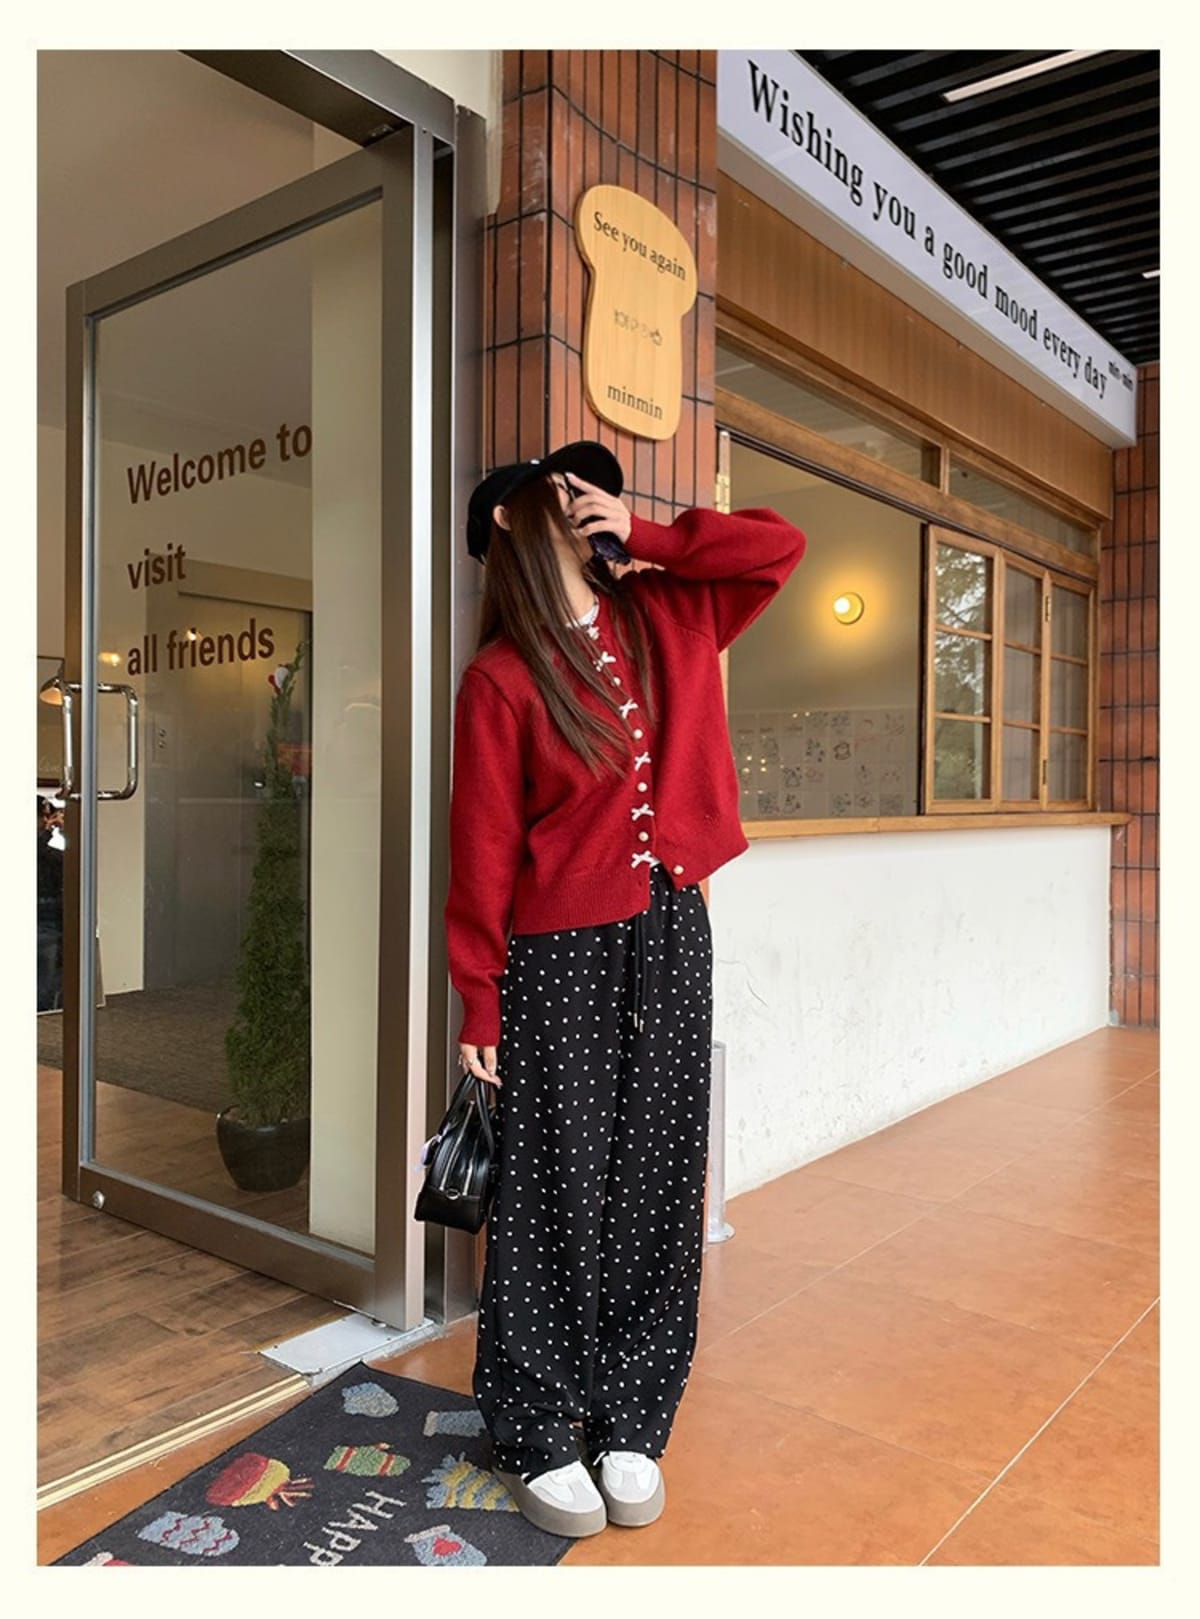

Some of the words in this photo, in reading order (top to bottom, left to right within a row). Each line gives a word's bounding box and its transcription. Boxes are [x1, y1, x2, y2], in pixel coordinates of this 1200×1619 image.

[593, 211, 619, 242] See
[622, 232, 648, 258] you
[649, 249, 686, 281] again
[747, 59, 864, 207] Wishing
[872, 181, 916, 240] you
[924, 225, 935, 257] a
[943, 243, 988, 299] good
[995, 285, 1038, 340] mood
[1043, 327, 1081, 379] every
[1084, 356, 1107, 400] day
[607, 385, 663, 421] minmin
[127, 438, 267, 504] Welcome
[276, 423, 313, 462] to
[127, 543, 187, 590] visit
[127, 634, 158, 676] all
[166, 618, 275, 671] friends
[303, 1491, 407, 1566] HAPP
